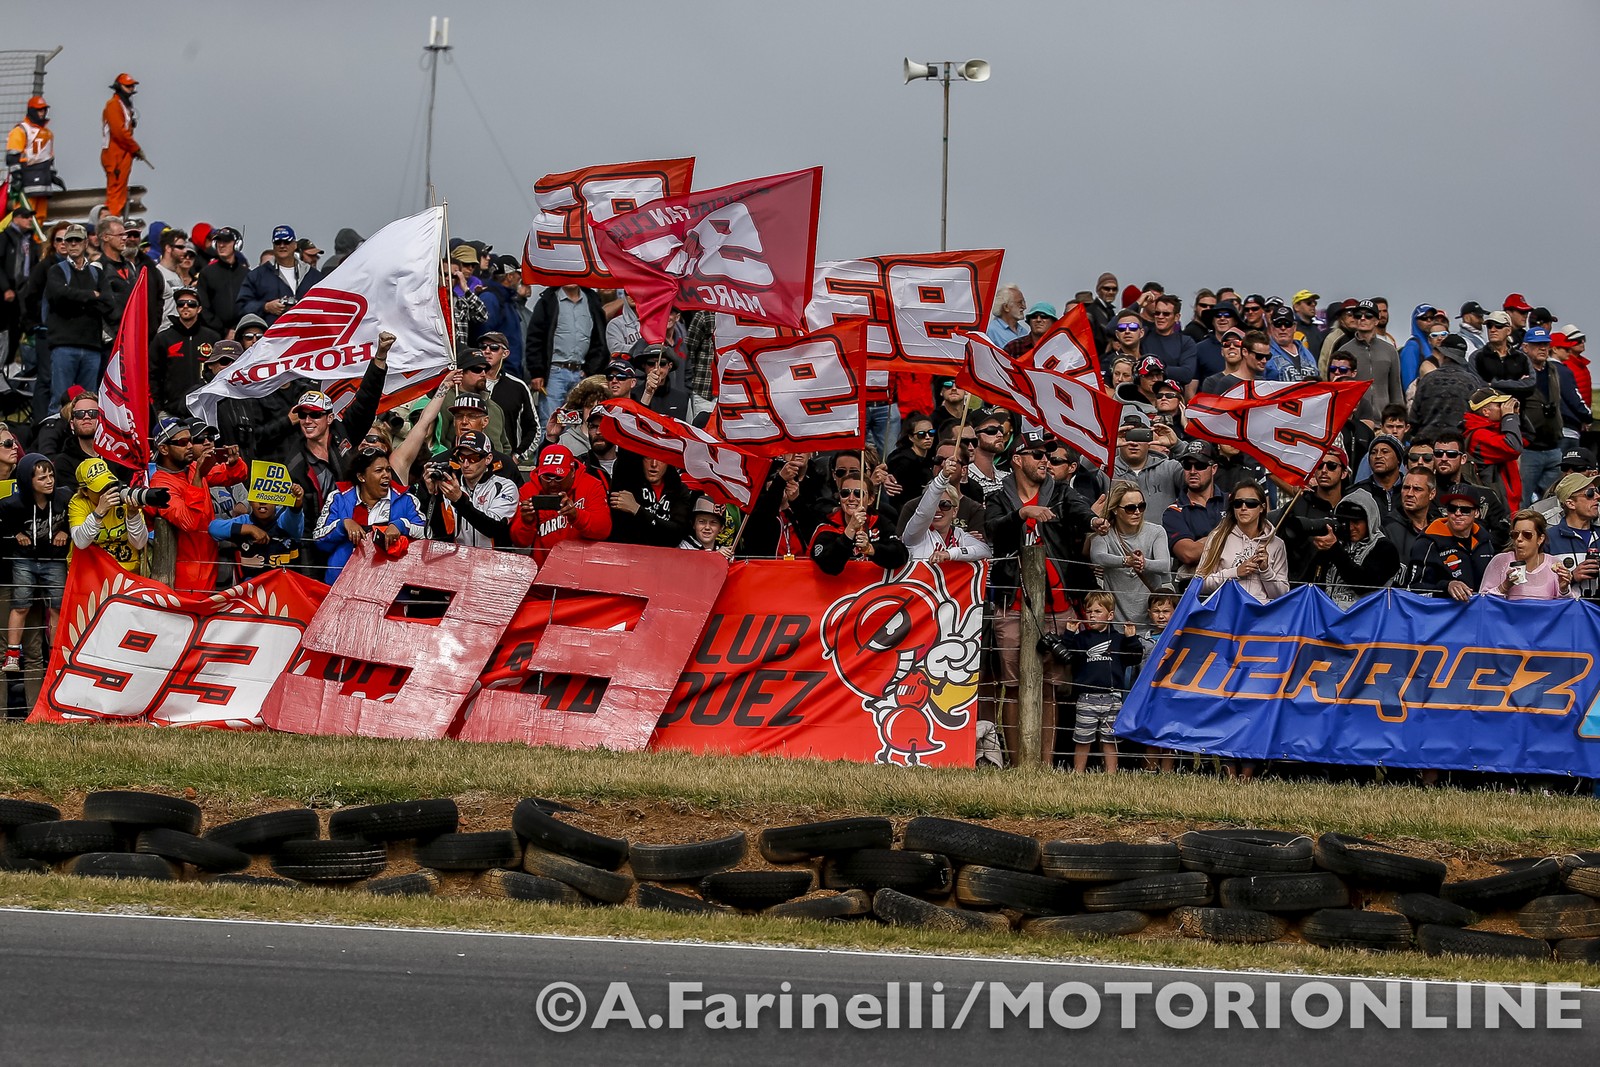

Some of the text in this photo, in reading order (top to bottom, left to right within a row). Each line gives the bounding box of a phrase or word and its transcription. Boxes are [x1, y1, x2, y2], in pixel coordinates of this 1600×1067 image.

[543, 454, 564, 465] 93
[87, 462, 107, 478] 46
[266, 465, 285, 479] GO
[695, 613, 812, 665] LUB
[47, 594, 308, 724] 93
